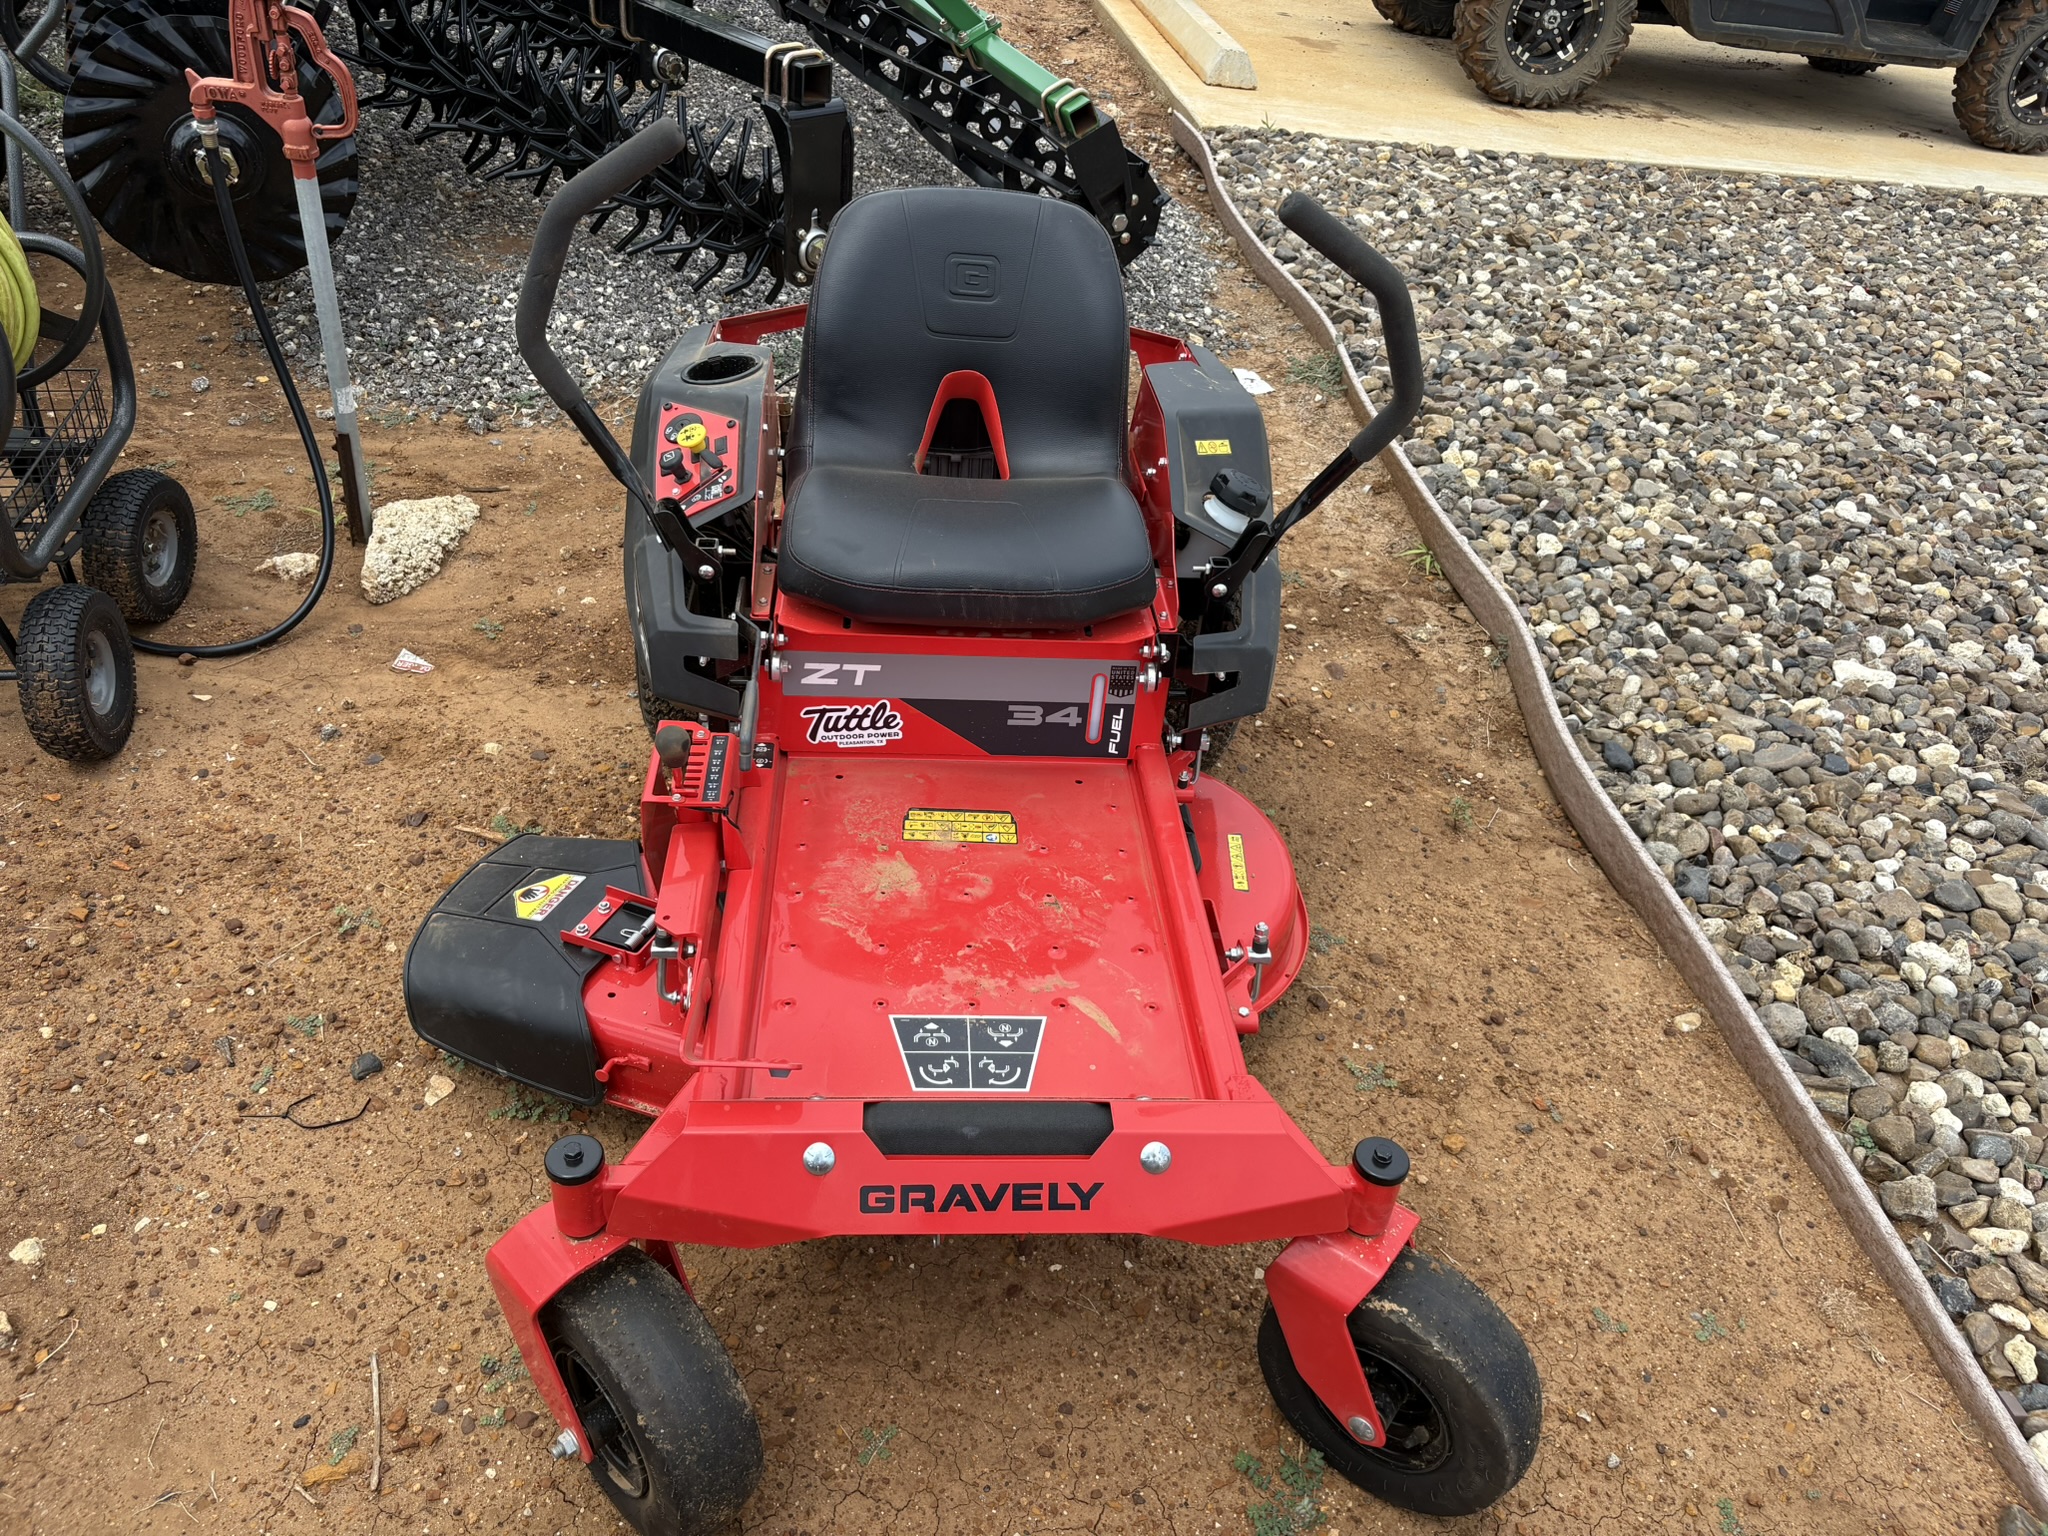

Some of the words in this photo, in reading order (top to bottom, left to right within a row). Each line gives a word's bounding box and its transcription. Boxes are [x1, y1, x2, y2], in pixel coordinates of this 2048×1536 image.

[236, 12, 248, 74] WOODFORD
[800, 662, 882, 686] ZT
[803, 702, 900, 742] Tuttle
[1007, 705, 1082, 727] 34
[1108, 707, 1124, 755] FUEL
[539, 880, 579, 915] DANGER
[859, 1182, 1105, 1214] GRAVELY
